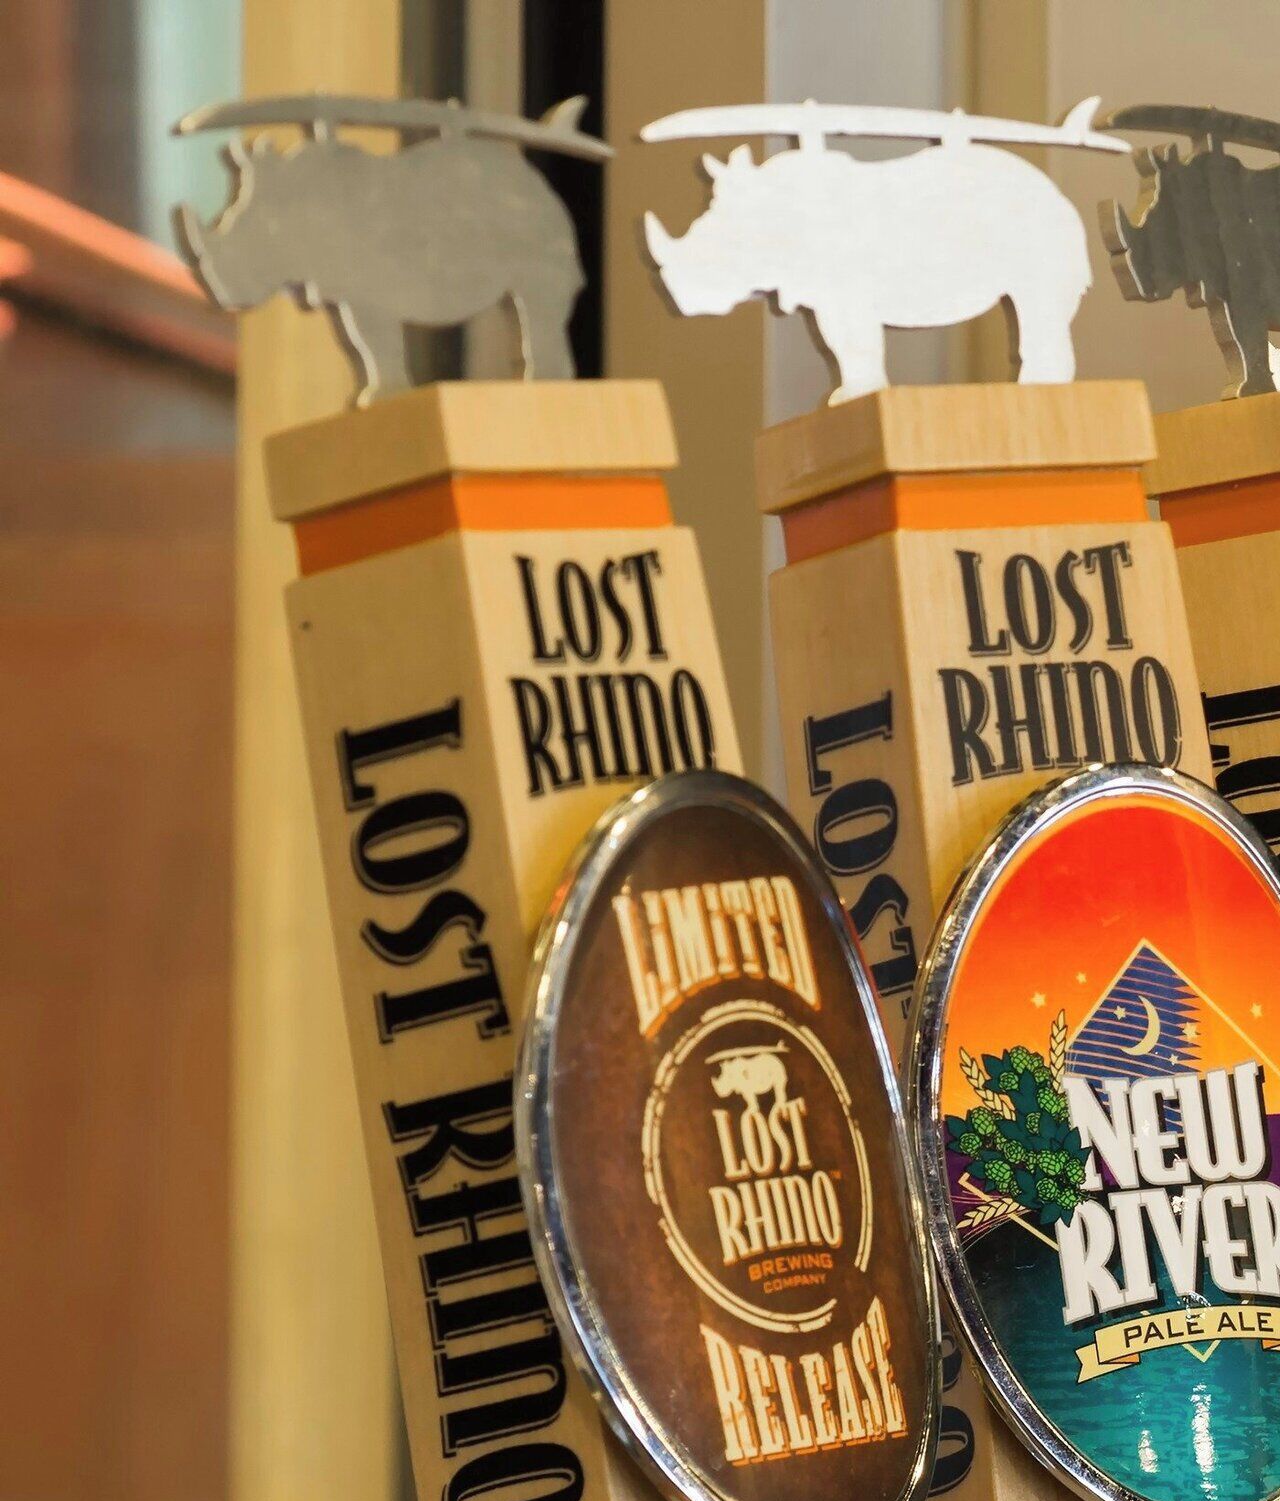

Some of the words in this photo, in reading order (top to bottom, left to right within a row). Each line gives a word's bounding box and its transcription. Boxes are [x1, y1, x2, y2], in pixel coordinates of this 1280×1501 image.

[514, 548, 668, 665] LOST
[954, 541, 1132, 658] LOST
[509, 668, 717, 798] RHINO
[937, 655, 1184, 788] RHINO
[333, 696, 512, 1045] LOST
[612, 876, 822, 1039] LIMITED
[711, 1097, 812, 1180] LOST
[1061, 1060, 1269, 1192] NEW
[708, 1169, 843, 1267] RHINO
[748, 1251, 834, 1283] BREWING
[762, 1273, 828, 1295] COMPANY
[1122, 1314, 1206, 1349] PALE
[1216, 1311, 1276, 1336] ALE
[700, 1295, 909, 1467] RELEASE
